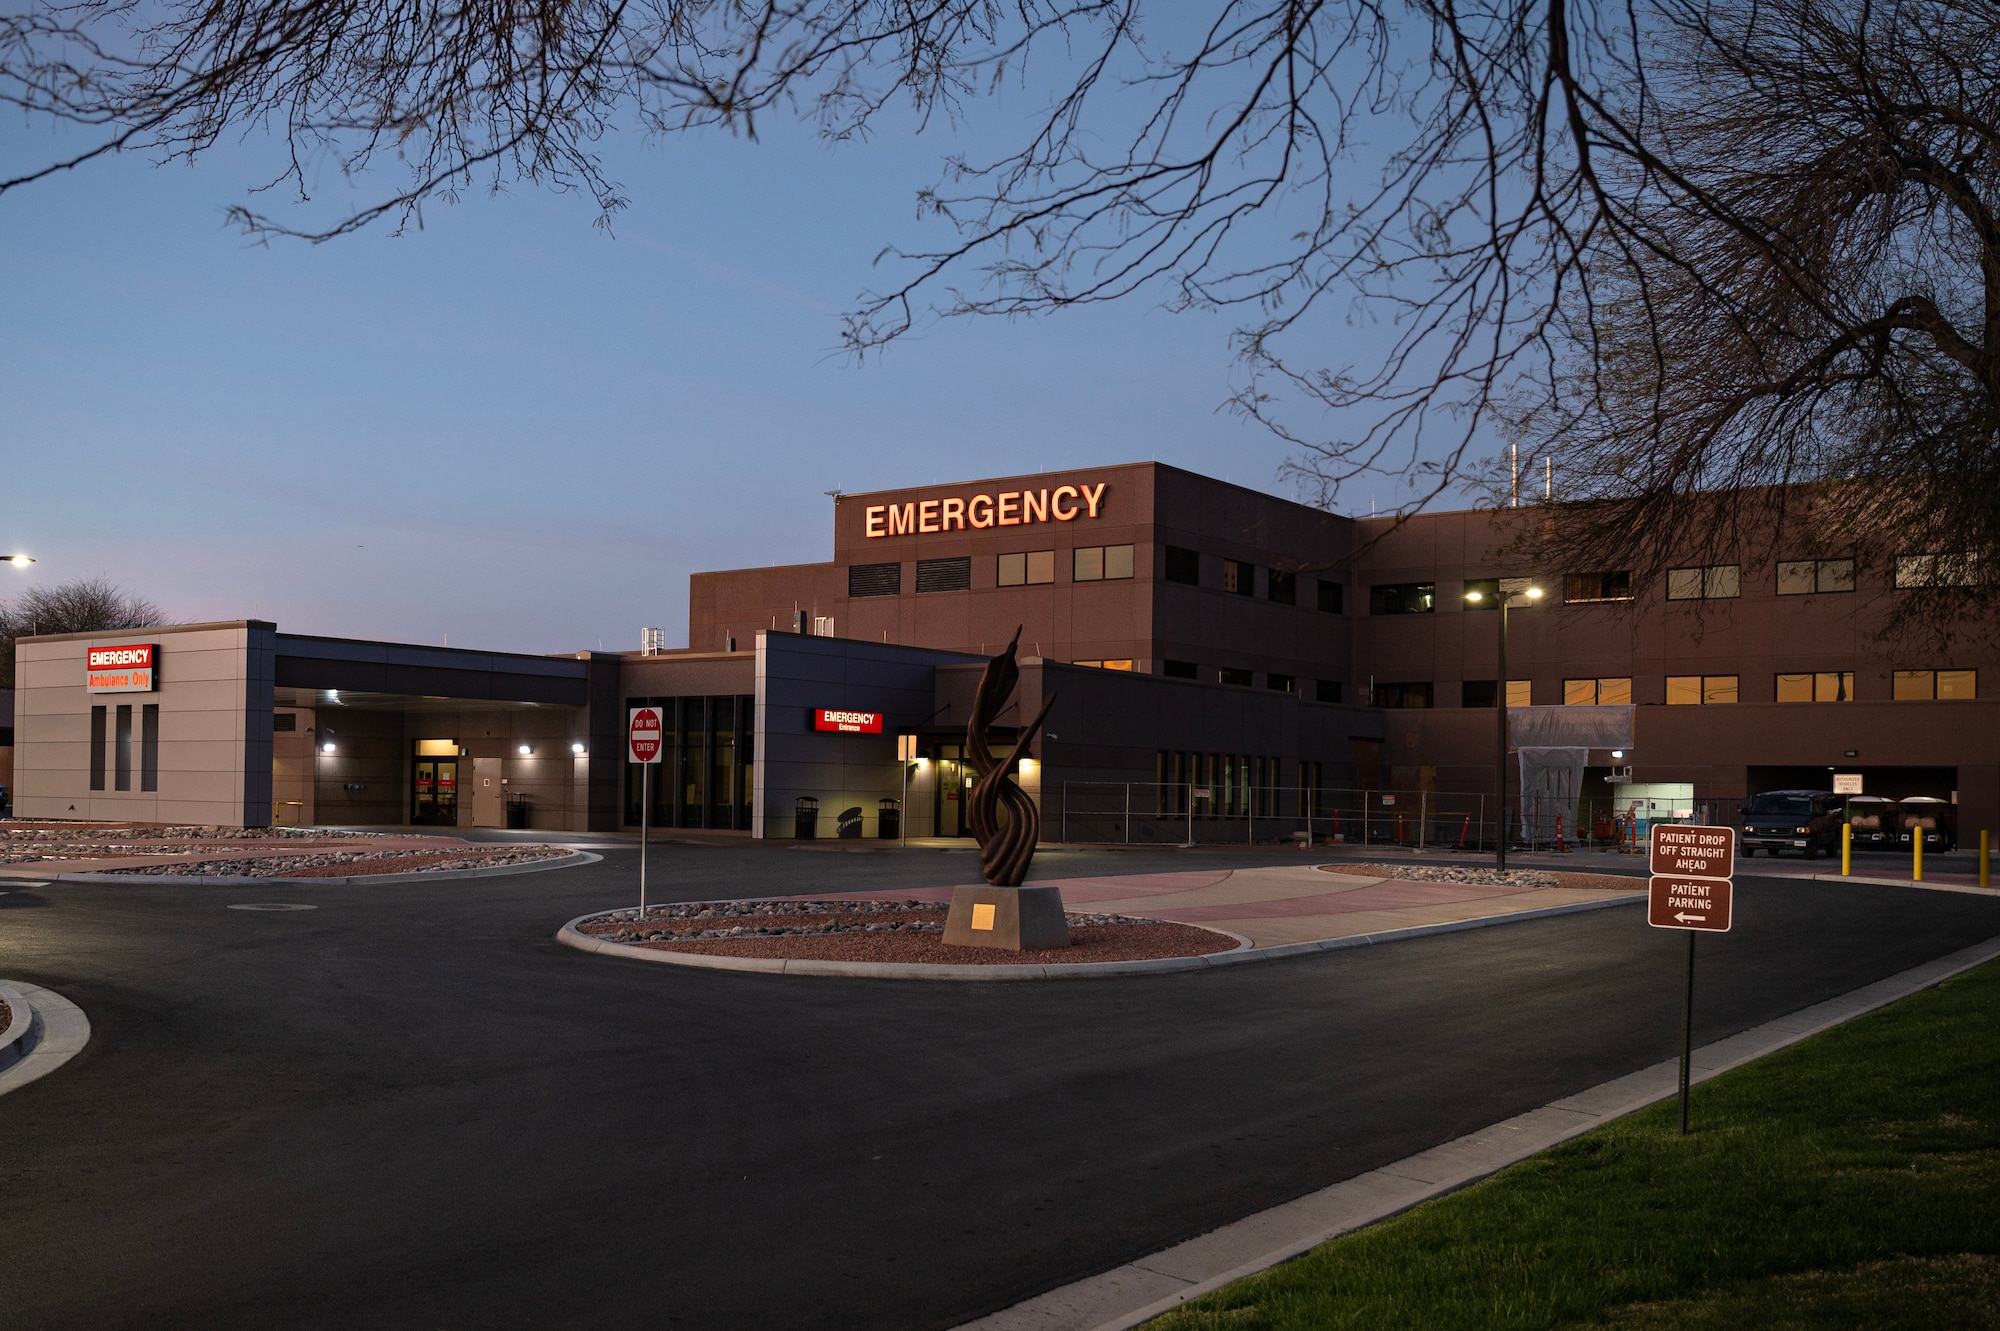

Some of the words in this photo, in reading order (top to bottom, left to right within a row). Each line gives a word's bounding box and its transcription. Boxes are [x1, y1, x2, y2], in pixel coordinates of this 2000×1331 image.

[865, 482, 1106, 538] EMERGENCY
[90, 649, 149, 666] EMERGENCY
[89, 673, 129, 687] Ambulance
[132, 671, 150, 688] Only
[634, 720, 644, 728] DO
[646, 719, 657, 728] NOT
[824, 711, 874, 724] EMERGENCY
[838, 723, 860, 732] Entrance
[636, 743, 654, 752] ENTER
[1660, 832, 1696, 844] PATIENT
[1700, 835, 1726, 846] DROP
[1660, 846, 1678, 856] OFF
[1680, 847, 1725, 858] STRAIGHT
[1676, 860, 1706, 870] AHEAD
[1671, 884, 1710, 896] PATIENT
[1668, 896, 1712, 910] PARKING
